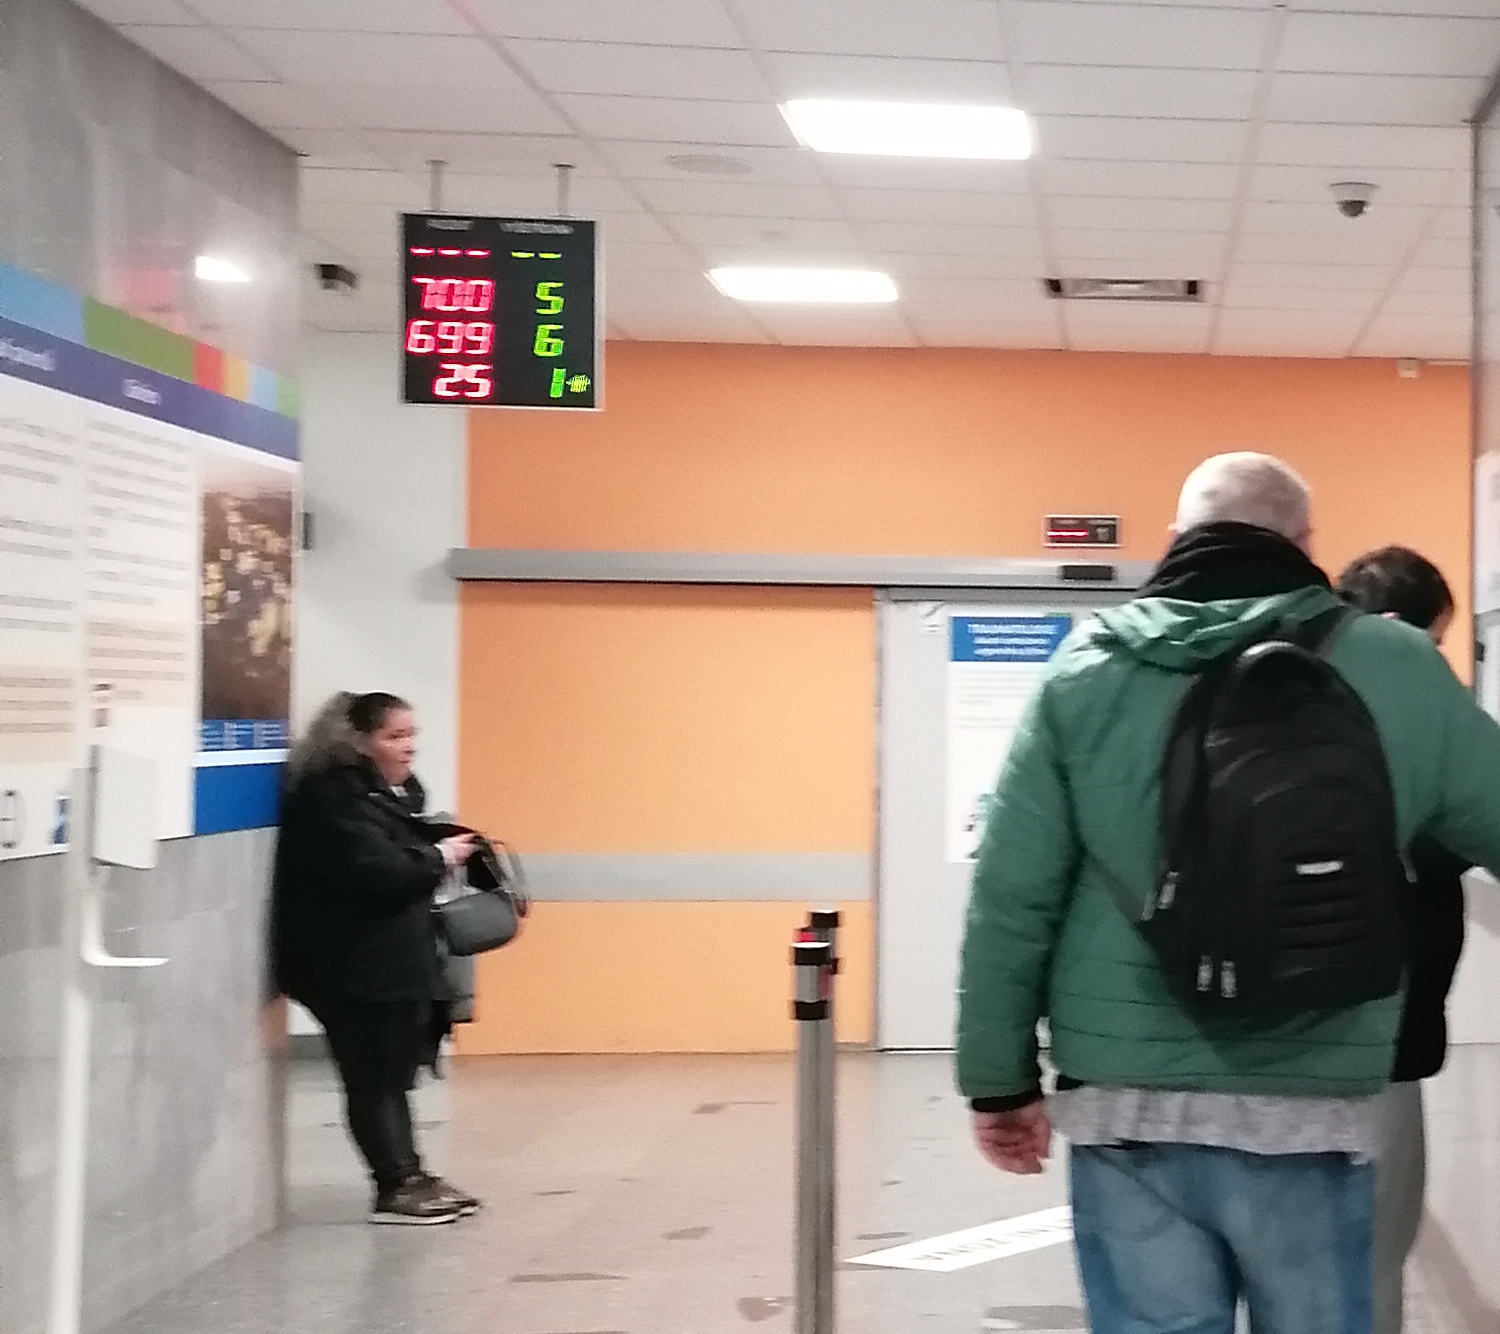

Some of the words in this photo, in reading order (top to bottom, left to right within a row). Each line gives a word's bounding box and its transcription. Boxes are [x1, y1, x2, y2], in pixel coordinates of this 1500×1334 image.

[535, 281, 565, 315] 5
[405, 318, 495, 355] 699
[533, 324, 565, 357] 6
